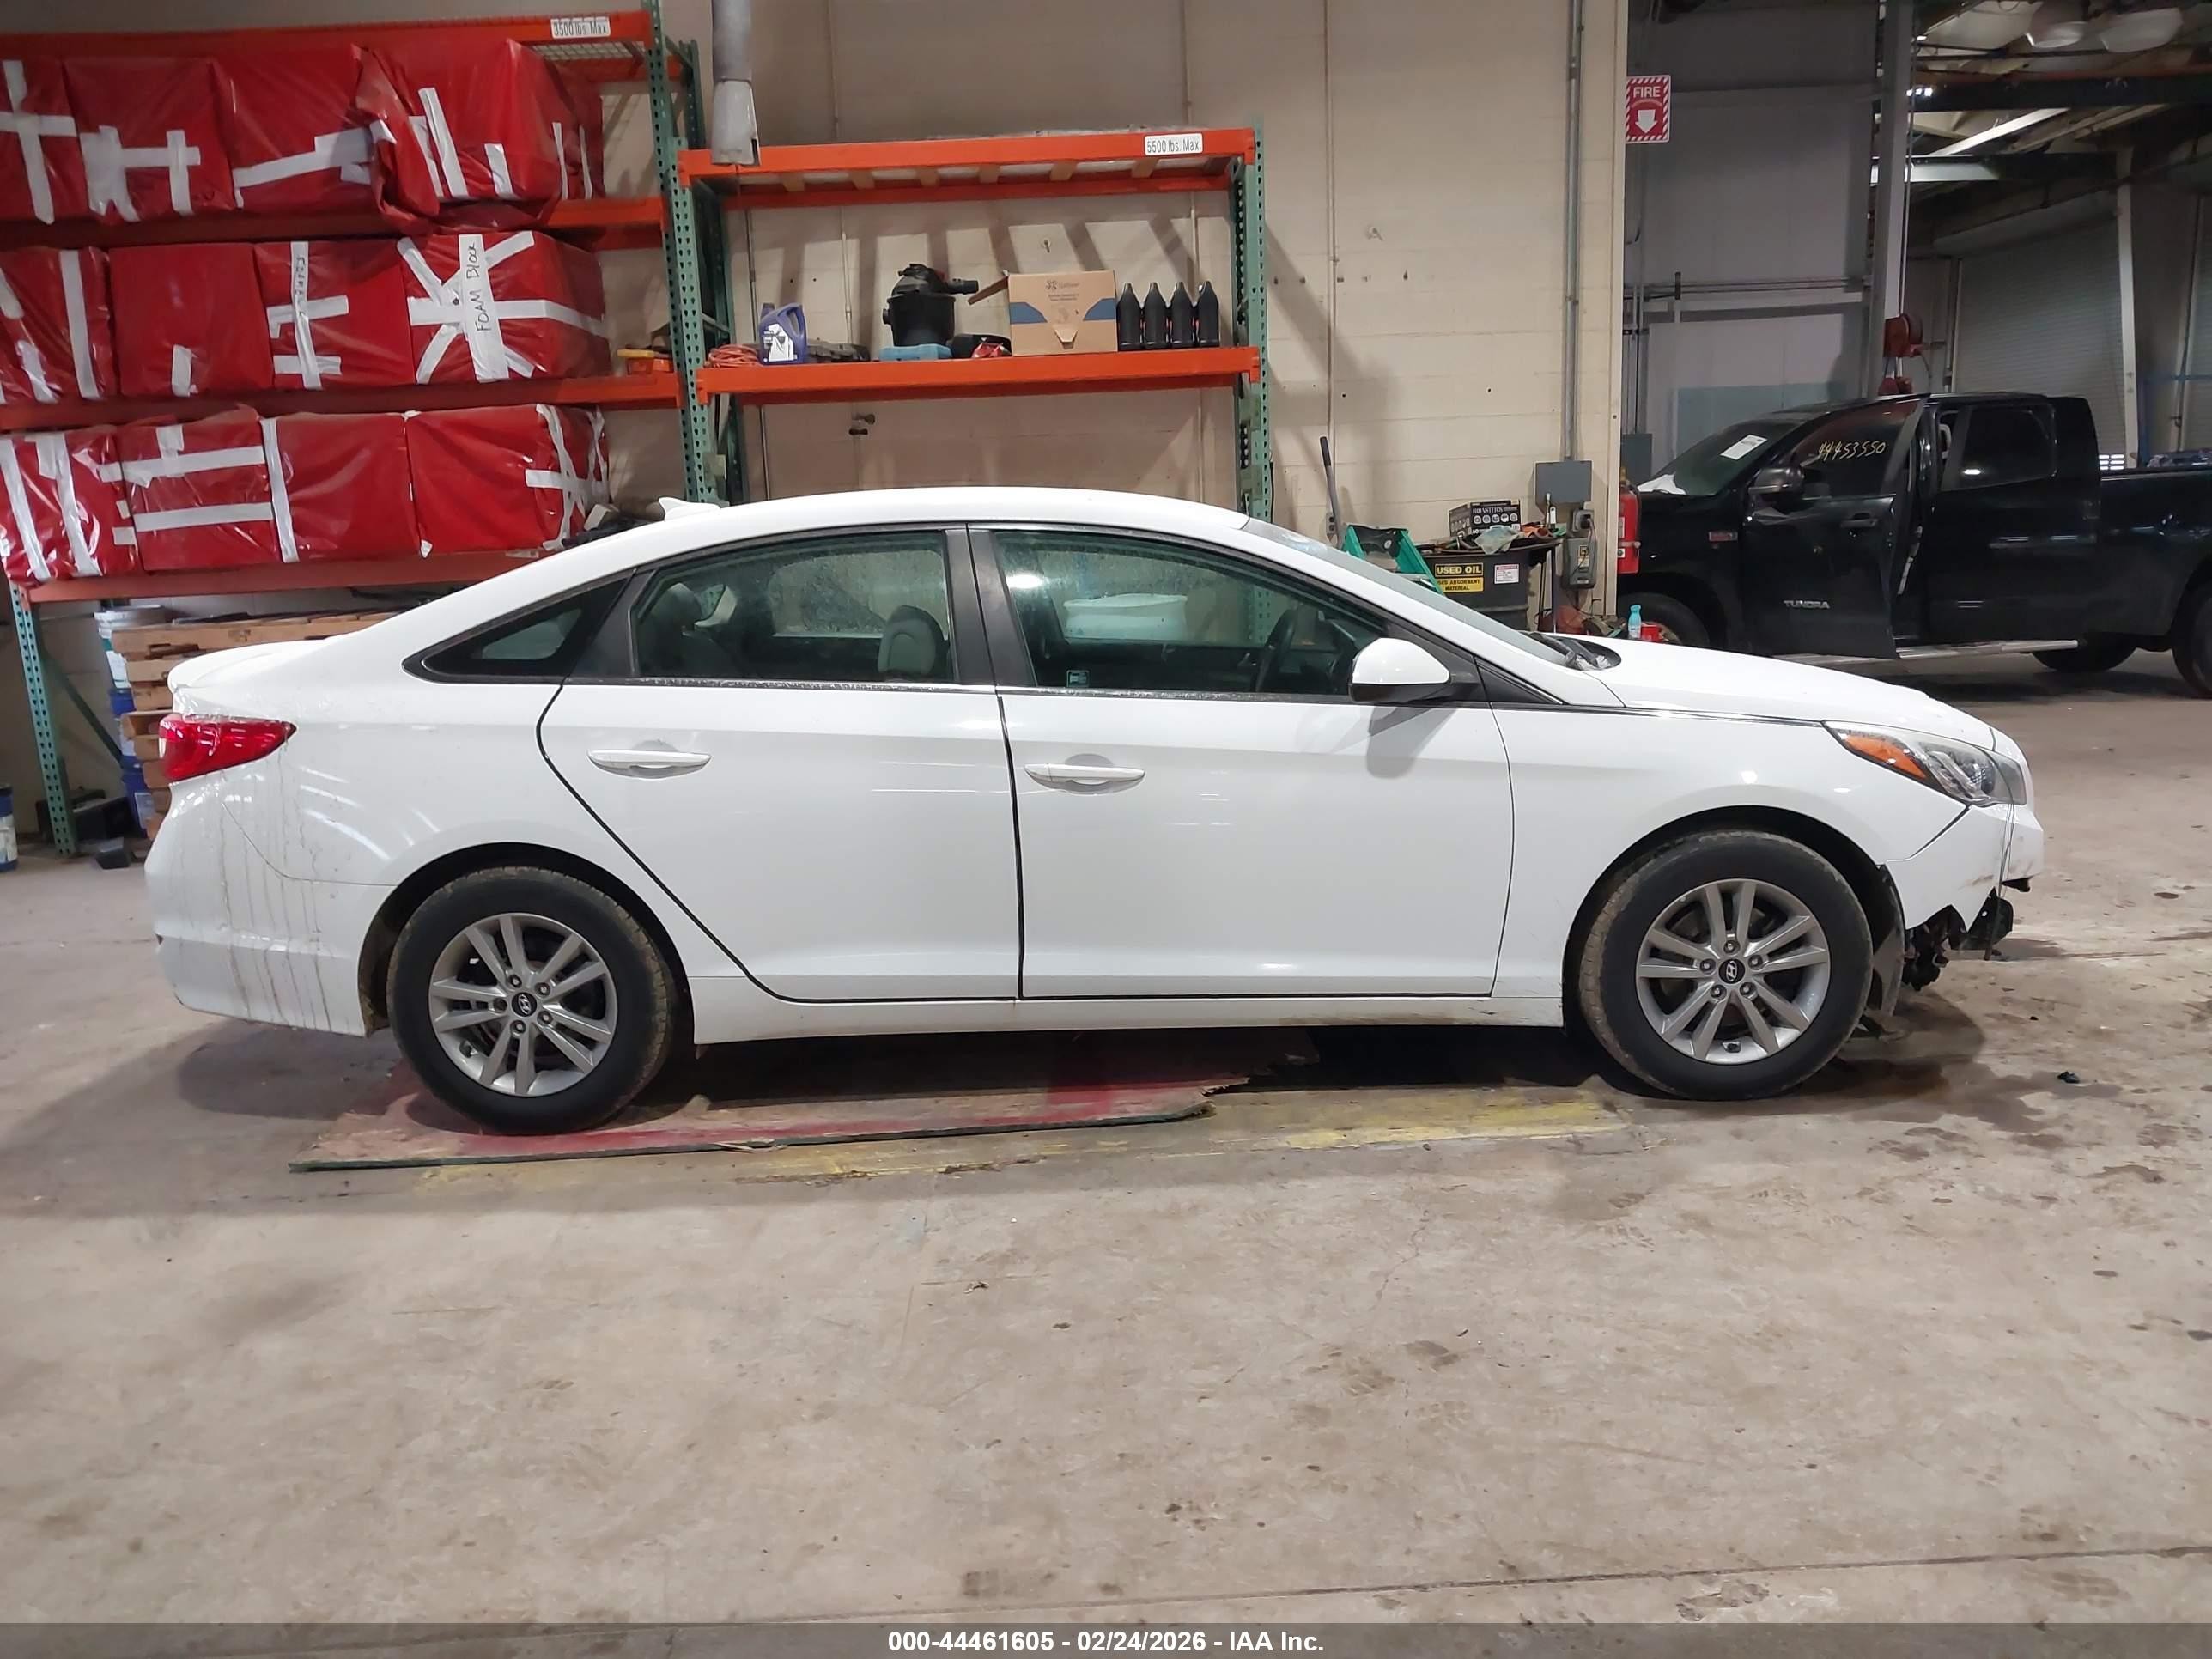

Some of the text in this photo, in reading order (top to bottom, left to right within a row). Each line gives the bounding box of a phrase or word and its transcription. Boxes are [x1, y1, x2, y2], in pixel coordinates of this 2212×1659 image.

[554, 21, 574, 36] 3500
[590, 20, 606, 34] Max
[1633, 86, 1662, 98] FIRE
[1147, 140, 1167, 153] 5500
[1182, 138, 1200, 151] Max
[469, 289, 491, 331] FOAM
[1818, 440, 1887, 461] 44453550
[1437, 566, 1462, 574] USED
